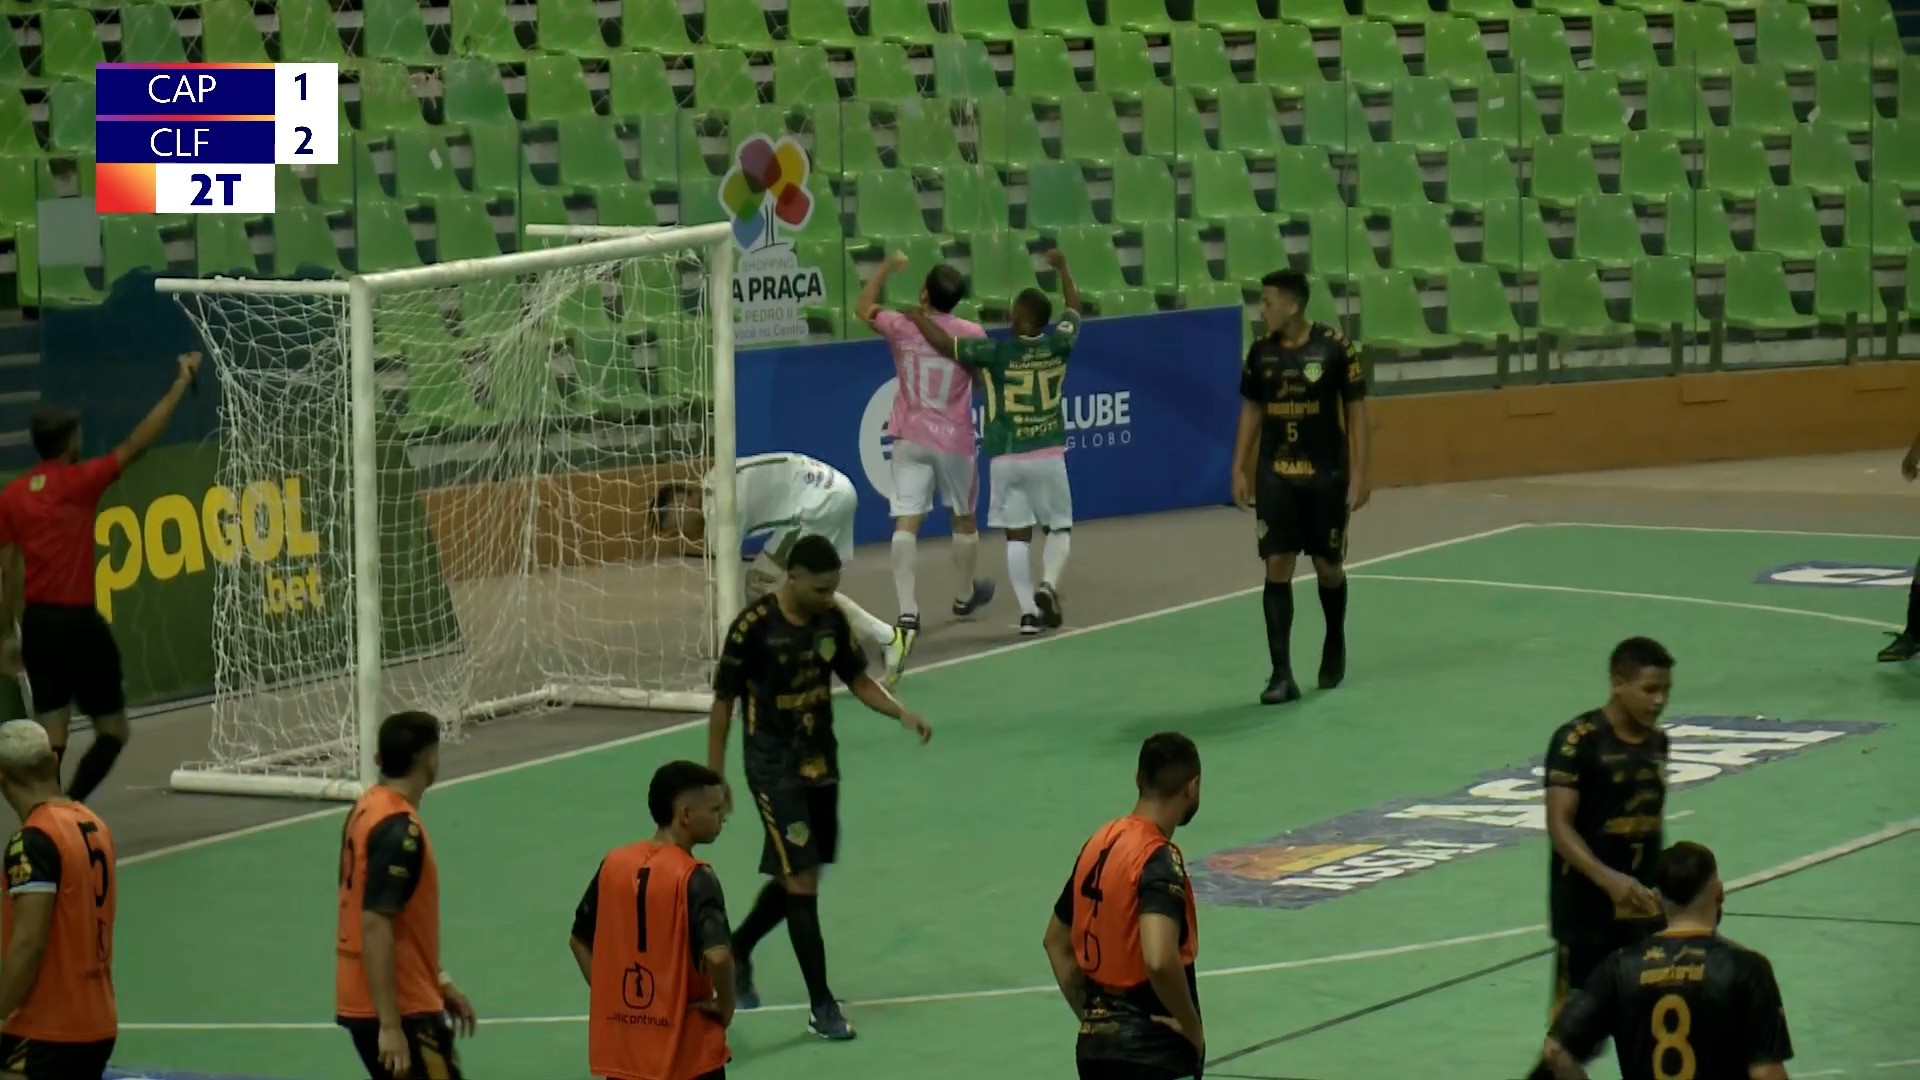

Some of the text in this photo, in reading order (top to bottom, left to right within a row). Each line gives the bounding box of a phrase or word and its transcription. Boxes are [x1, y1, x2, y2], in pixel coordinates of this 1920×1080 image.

[745, 307, 783, 322] PEDRO
[748, 272, 822, 303] PRAÇA
[903, 349, 954, 409] 10
[1003, 364, 1067, 412] 20
[1066, 430, 1131, 450] GLOBO
[1286, 421, 1298, 442] 5
[77, 820, 109, 909] 5
[1081, 836, 1116, 918] 4
[636, 866, 651, 953] 1
[1652, 994, 1697, 1080] 8
